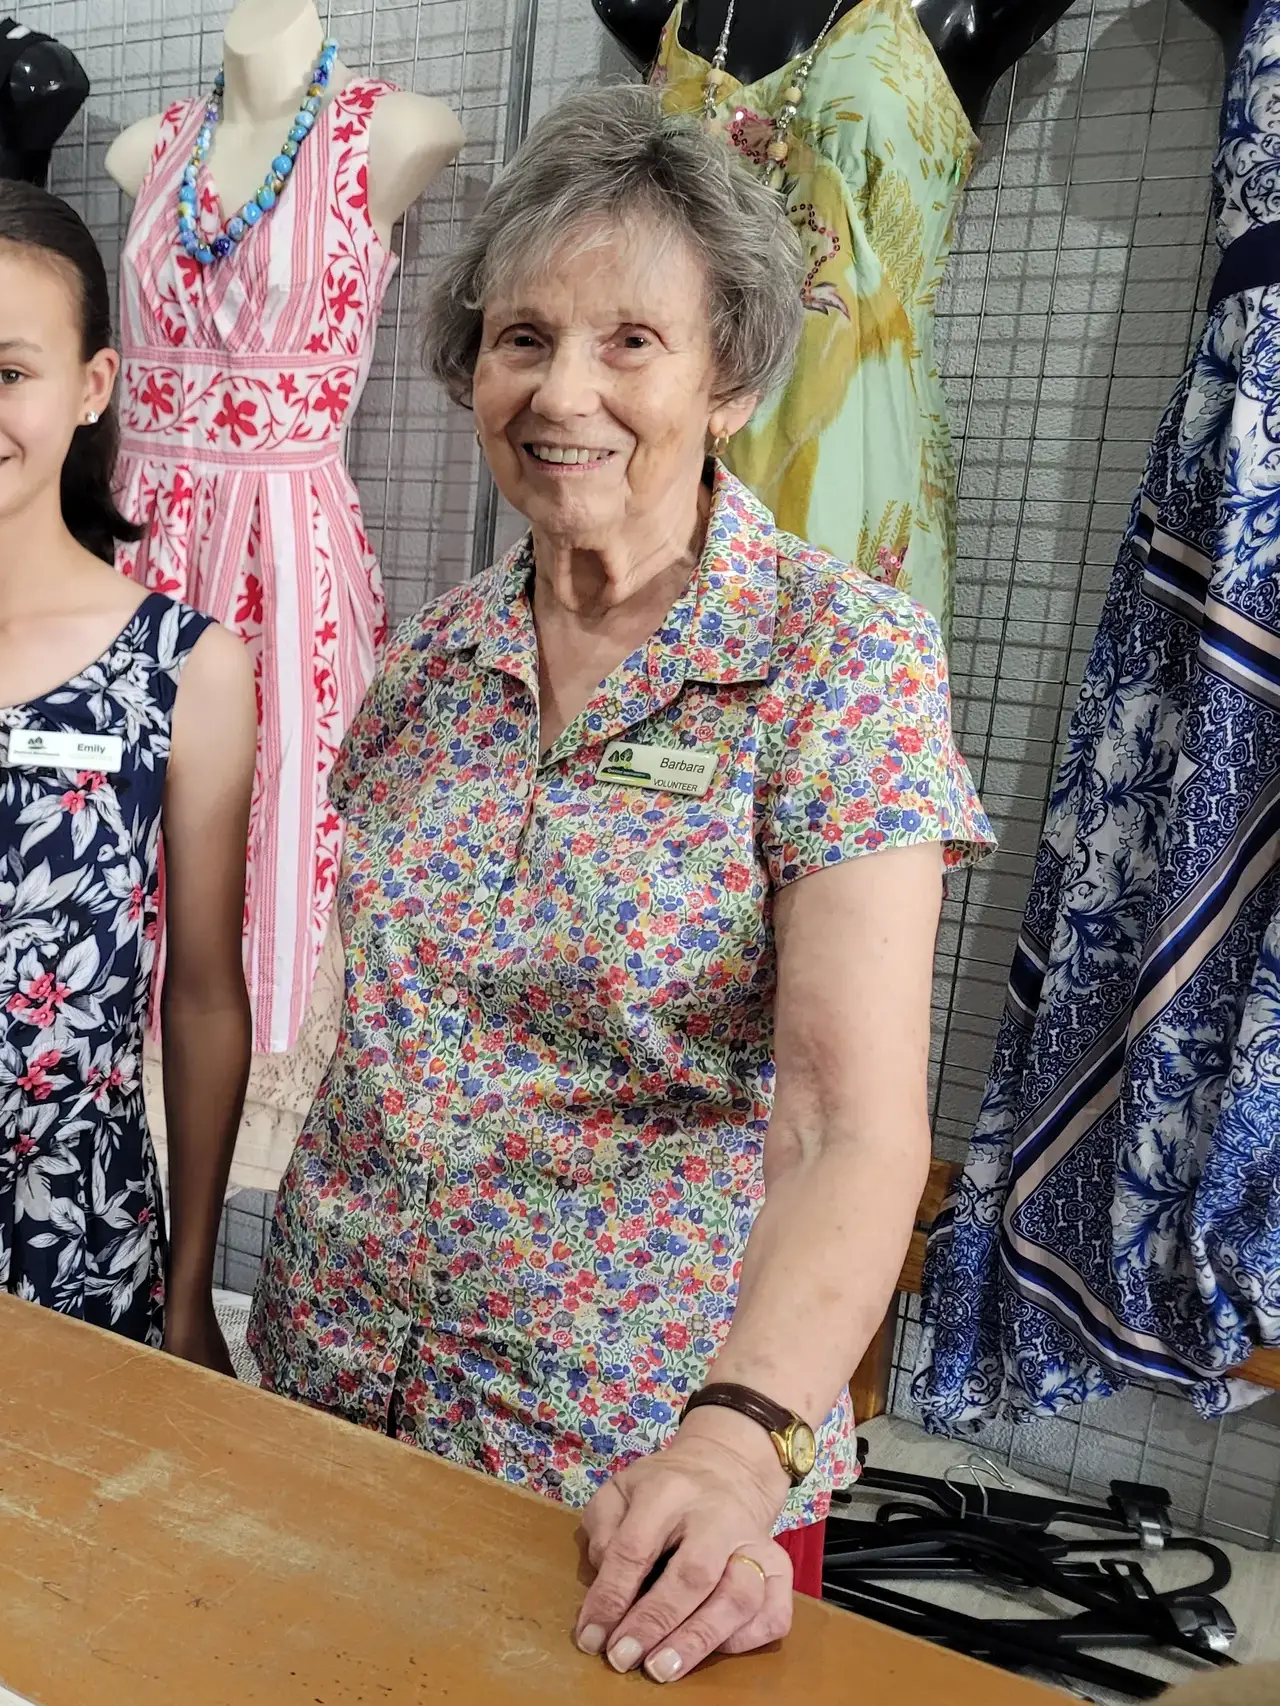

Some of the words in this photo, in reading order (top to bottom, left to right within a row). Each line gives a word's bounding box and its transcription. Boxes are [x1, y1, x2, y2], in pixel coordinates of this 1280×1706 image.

[77, 743, 106, 754] Emily
[660, 757, 705, 774] Barbara
[653, 778, 698, 792] VOLUNTEER
